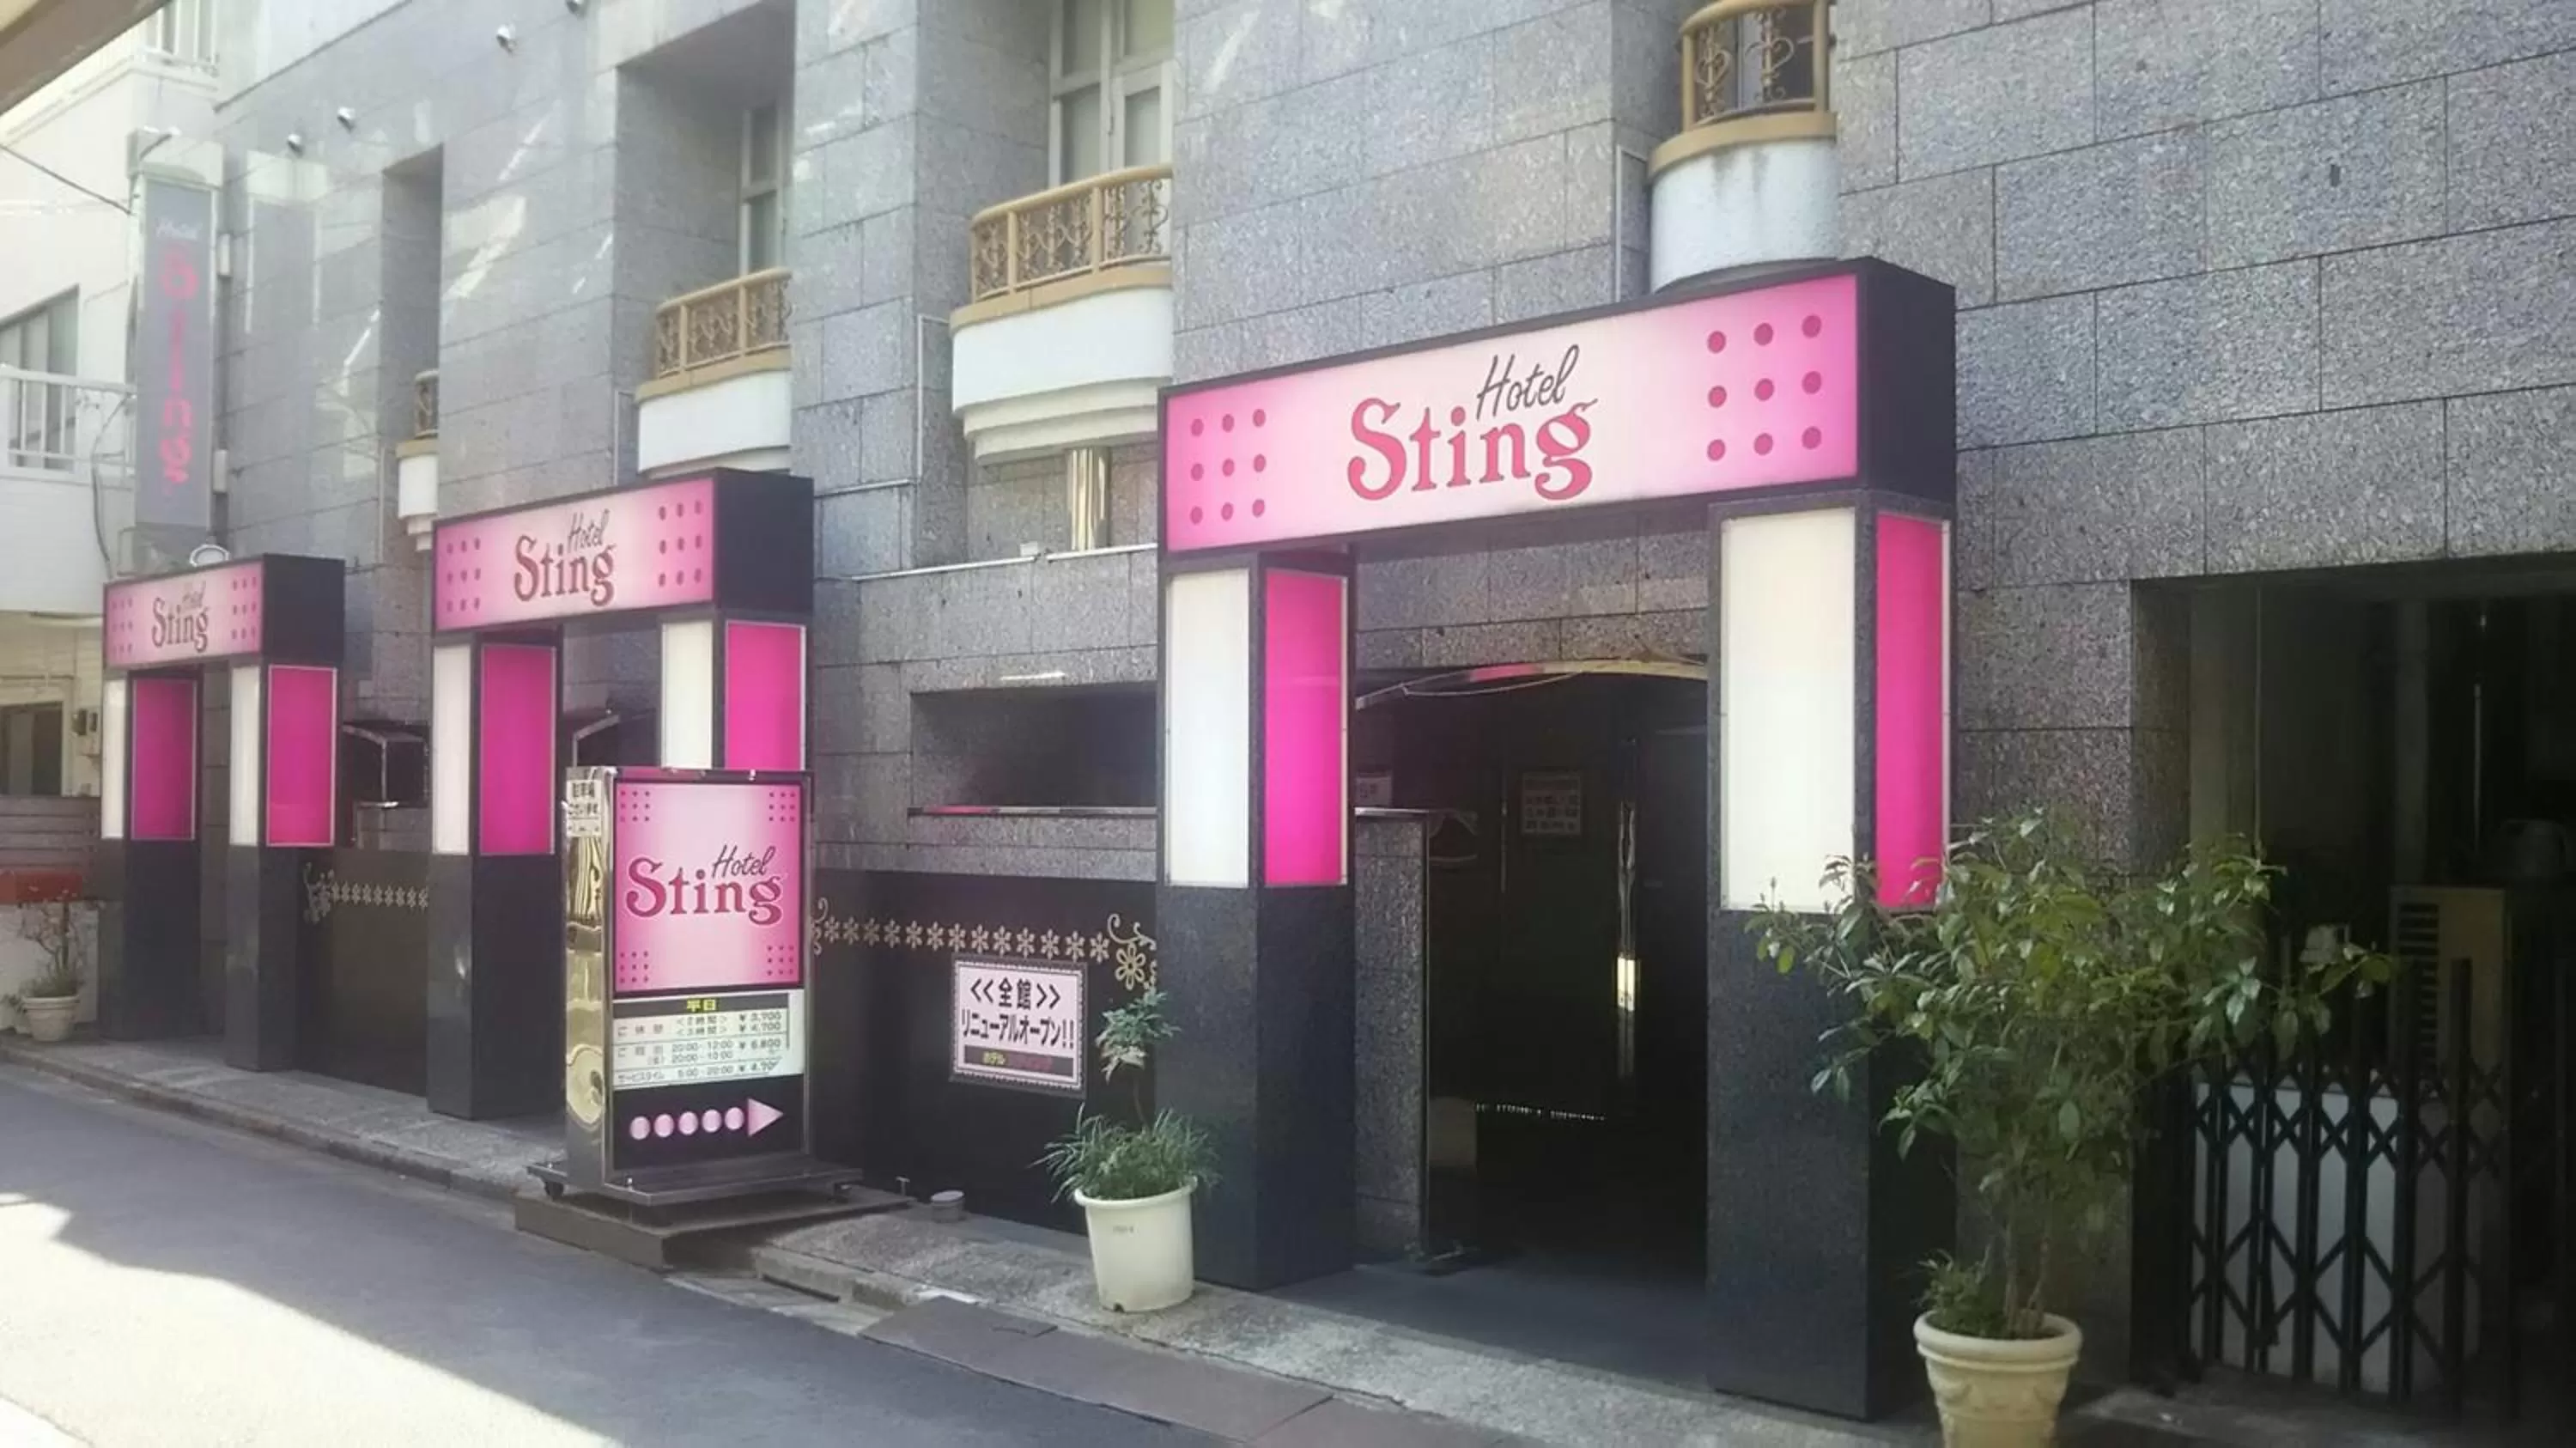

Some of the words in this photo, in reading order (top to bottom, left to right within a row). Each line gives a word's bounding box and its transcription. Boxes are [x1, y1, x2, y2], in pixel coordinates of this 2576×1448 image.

[1475, 344, 1580, 420] Hotel
[1347, 398, 1598, 501] Sting
[567, 508, 611, 554] Hotel
[514, 534, 617, 606] Sting
[151, 597, 210, 653] Sting
[625, 857, 784, 926] Sting
[711, 844, 776, 879] Hotel
